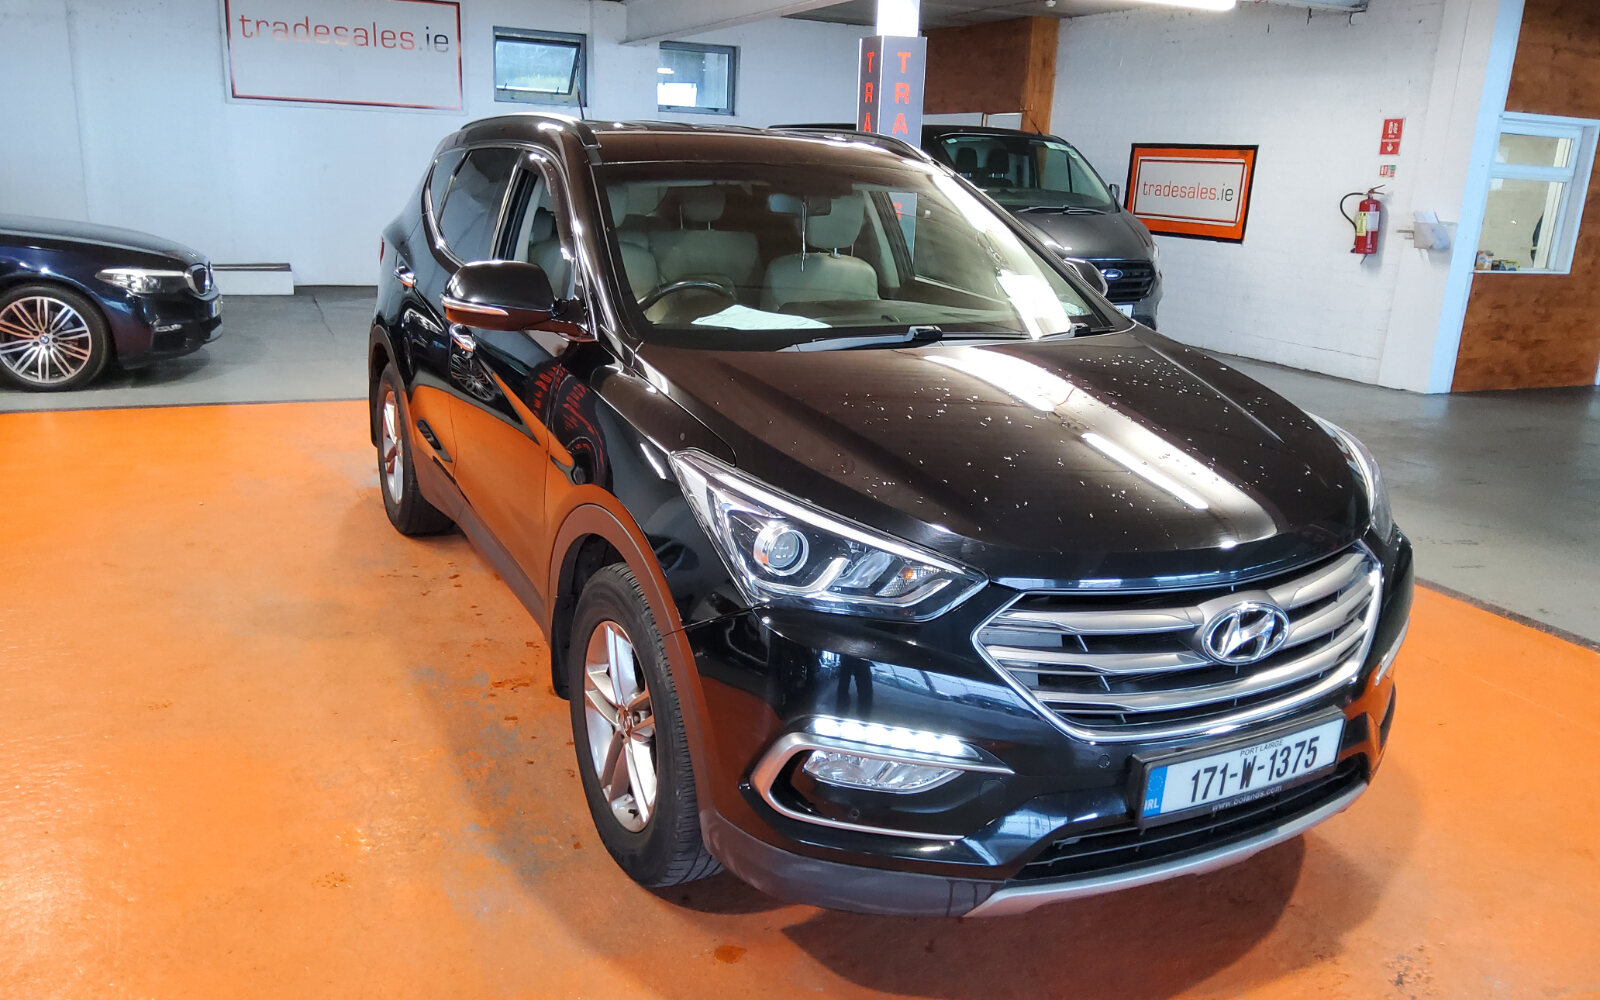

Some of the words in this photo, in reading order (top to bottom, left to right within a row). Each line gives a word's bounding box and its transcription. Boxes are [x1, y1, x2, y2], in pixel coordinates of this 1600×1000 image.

[238, 14, 450, 53] tradesales.ie
[1142, 180, 1234, 202] tradesales.ie
[1239, 746, 1258, 757] PORT
[1190, 735, 1321, 803] 171-W-1375
[1143, 797, 1159, 811] IRL
